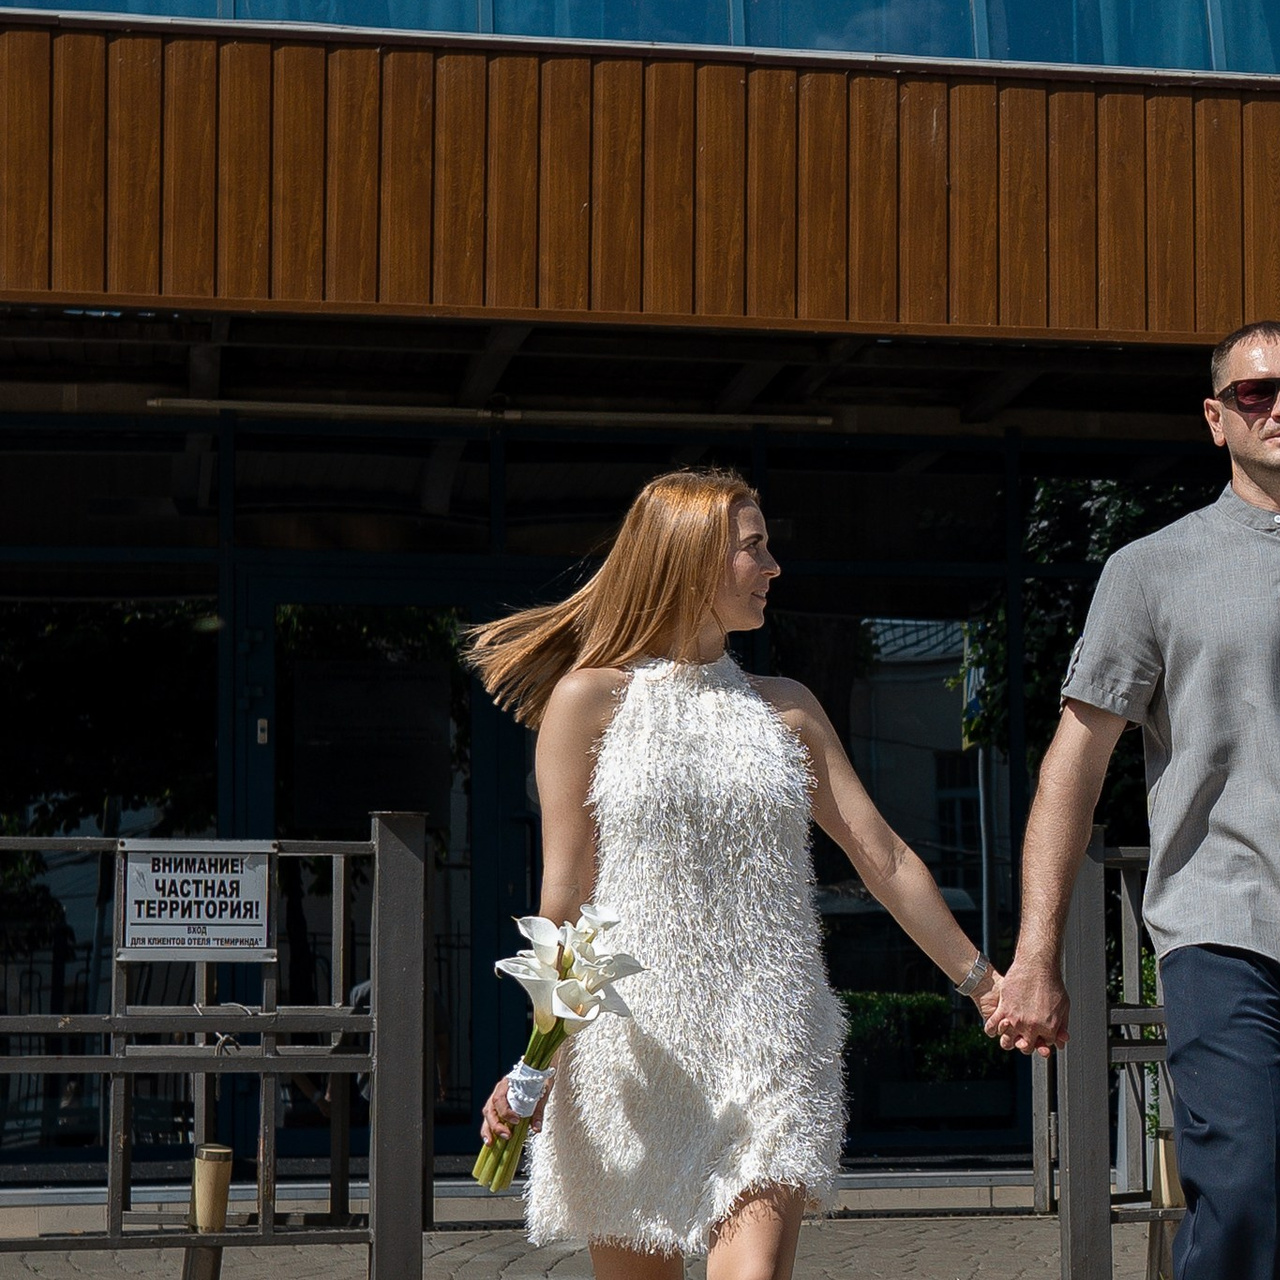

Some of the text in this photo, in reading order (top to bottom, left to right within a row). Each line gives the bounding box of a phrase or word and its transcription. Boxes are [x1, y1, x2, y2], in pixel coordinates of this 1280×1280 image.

[151, 857, 244, 874] ВНИМАНИЕ!
[154, 879, 240, 898] ЧАСТНАЯ
[134, 900, 260, 919] ТЕРРИТОРИЯ!
[187, 926, 207, 935] ВХОД
[131, 937, 146, 947] ДЛЯ
[148, 937, 186, 946] КЛИЕНТОВ
[187, 937, 211, 946] ОТЕЛЯ
